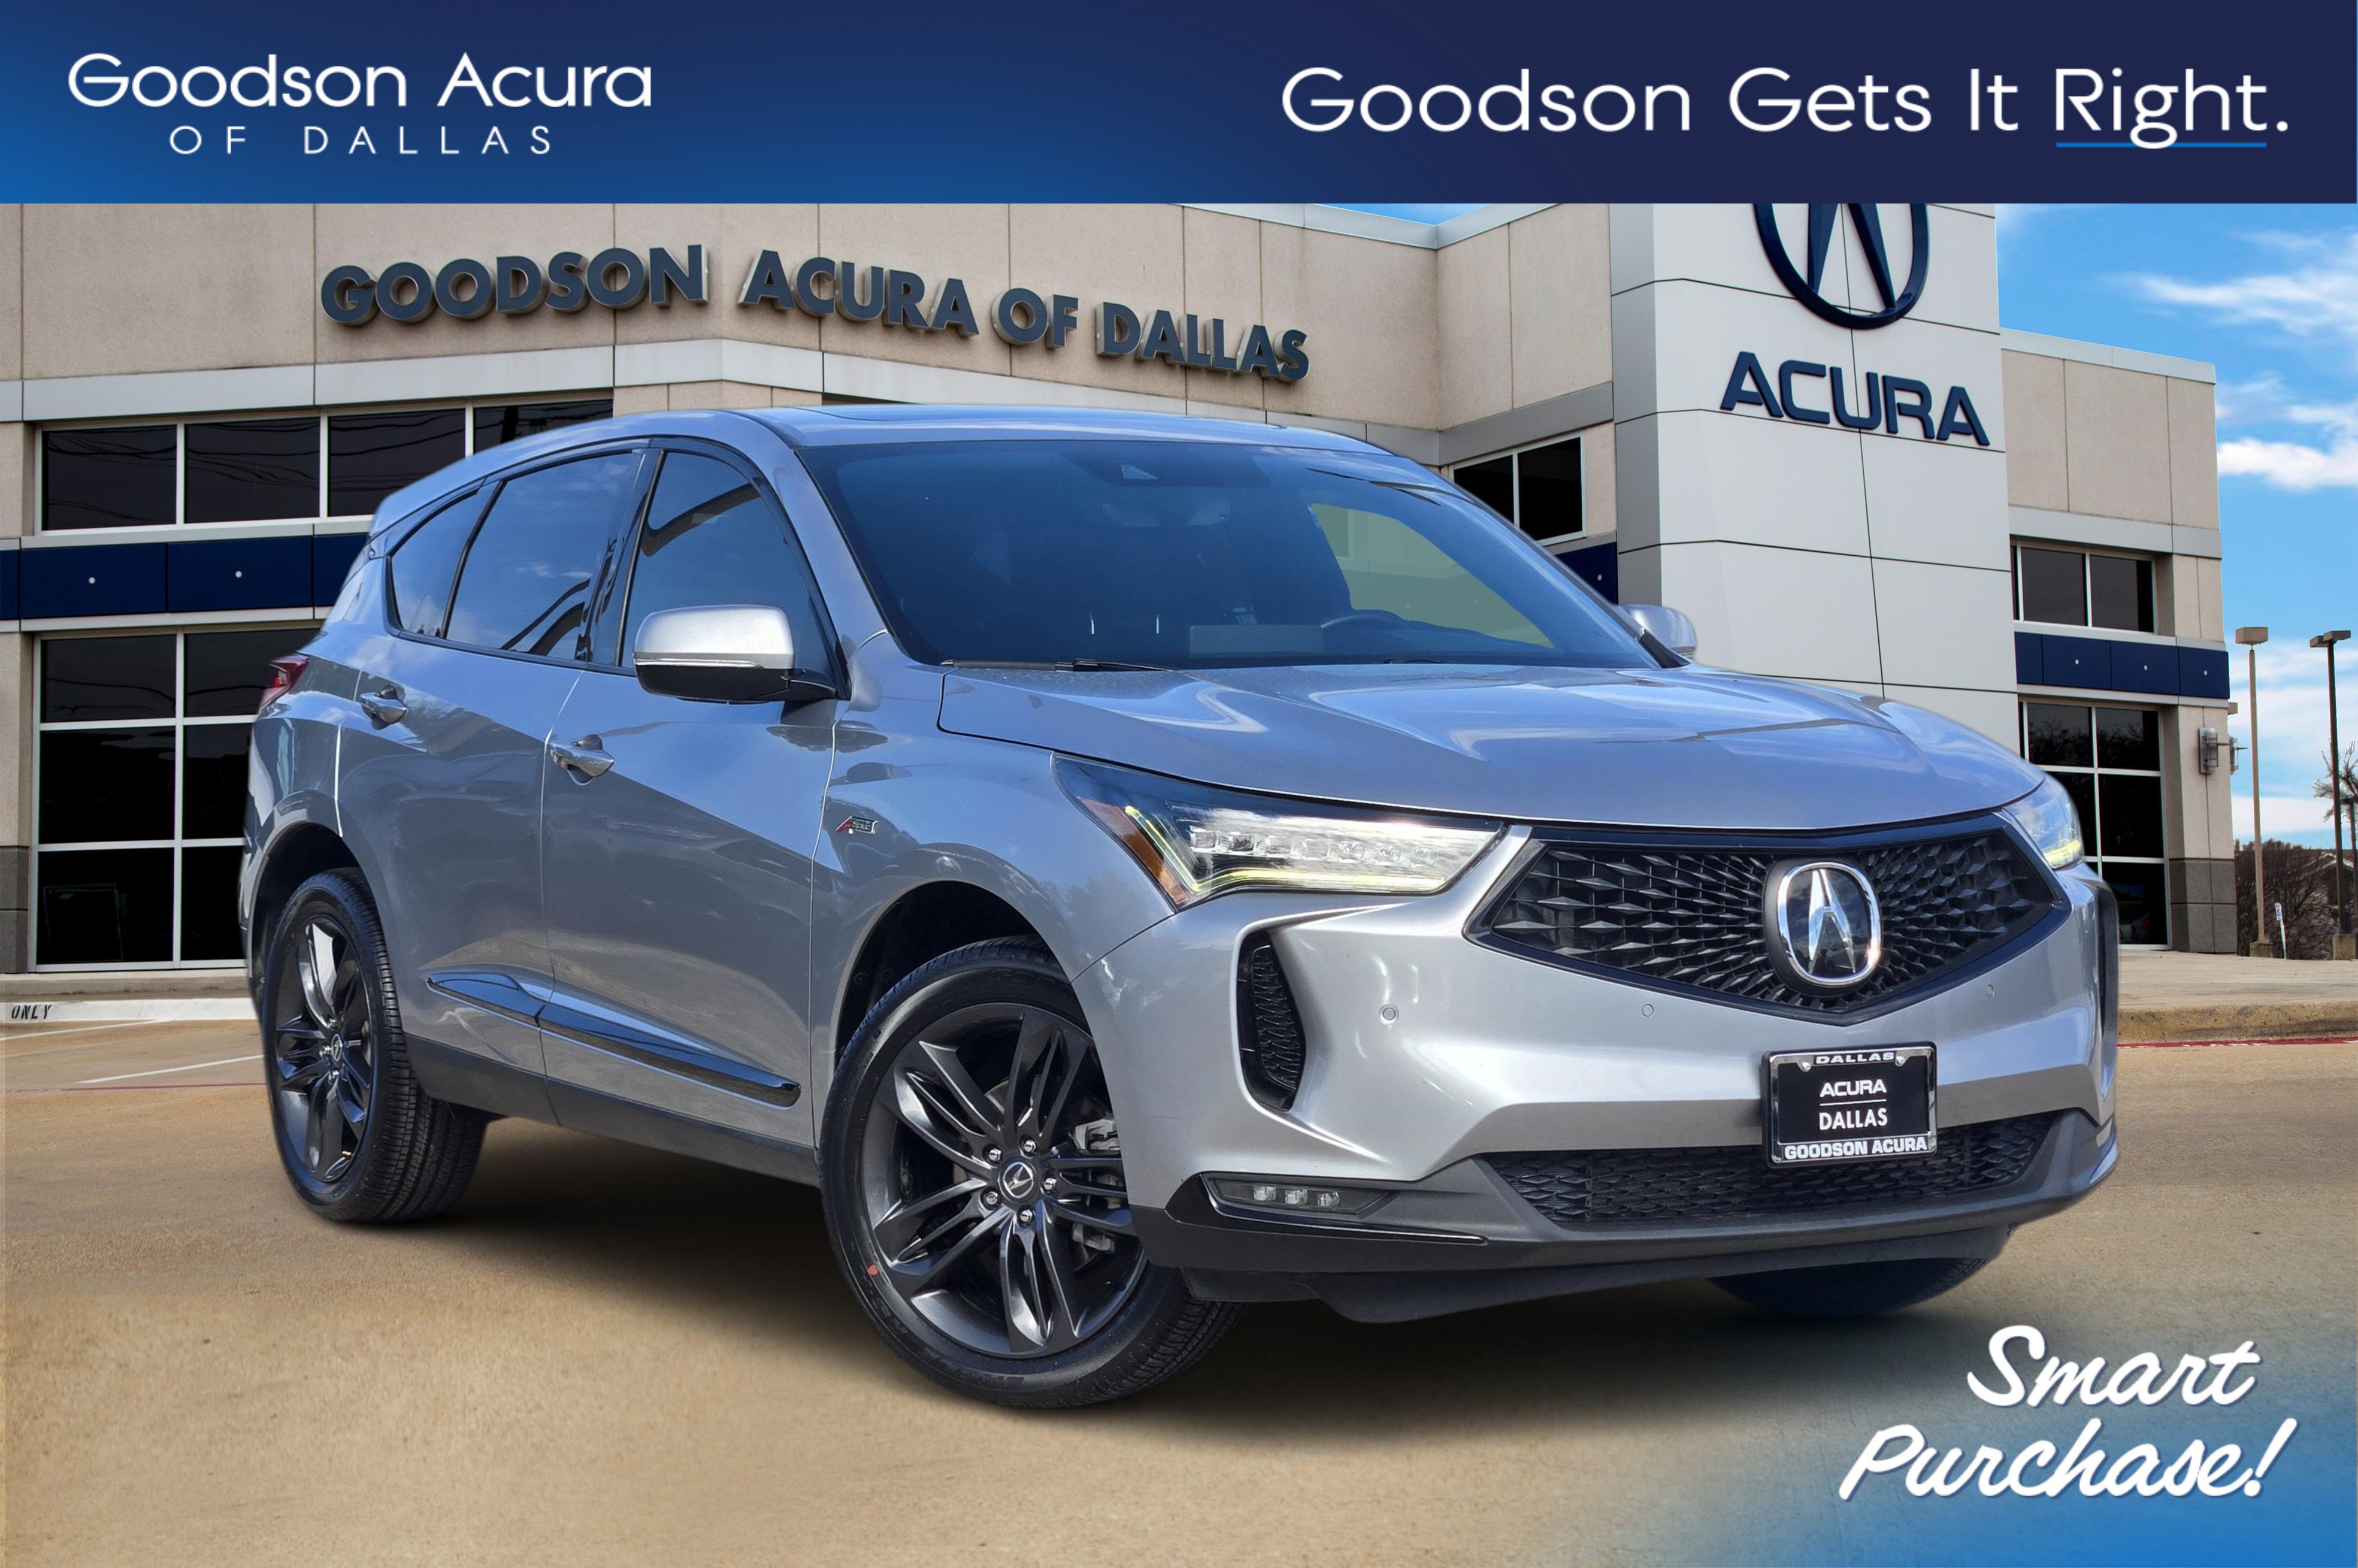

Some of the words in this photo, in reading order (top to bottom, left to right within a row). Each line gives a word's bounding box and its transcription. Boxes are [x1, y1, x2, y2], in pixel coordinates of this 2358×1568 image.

[320, 244, 708, 326] GOODSON
[737, 249, 979, 335] ACURA
[991, 287, 1077, 349] OF
[1095, 301, 1309, 382] DALLAS
[1720, 351, 1990, 446] ACURA
[11, 1004, 52, 1019] ONLY
[1816, 1052, 1894, 1064] DALLAS
[1820, 1079, 1887, 1097] ACURA
[1820, 1108, 1887, 1130] DALLAS
[1784, 1140, 1867, 1160] GOODSON
[1872, 1137, 1927, 1155] ACURA
